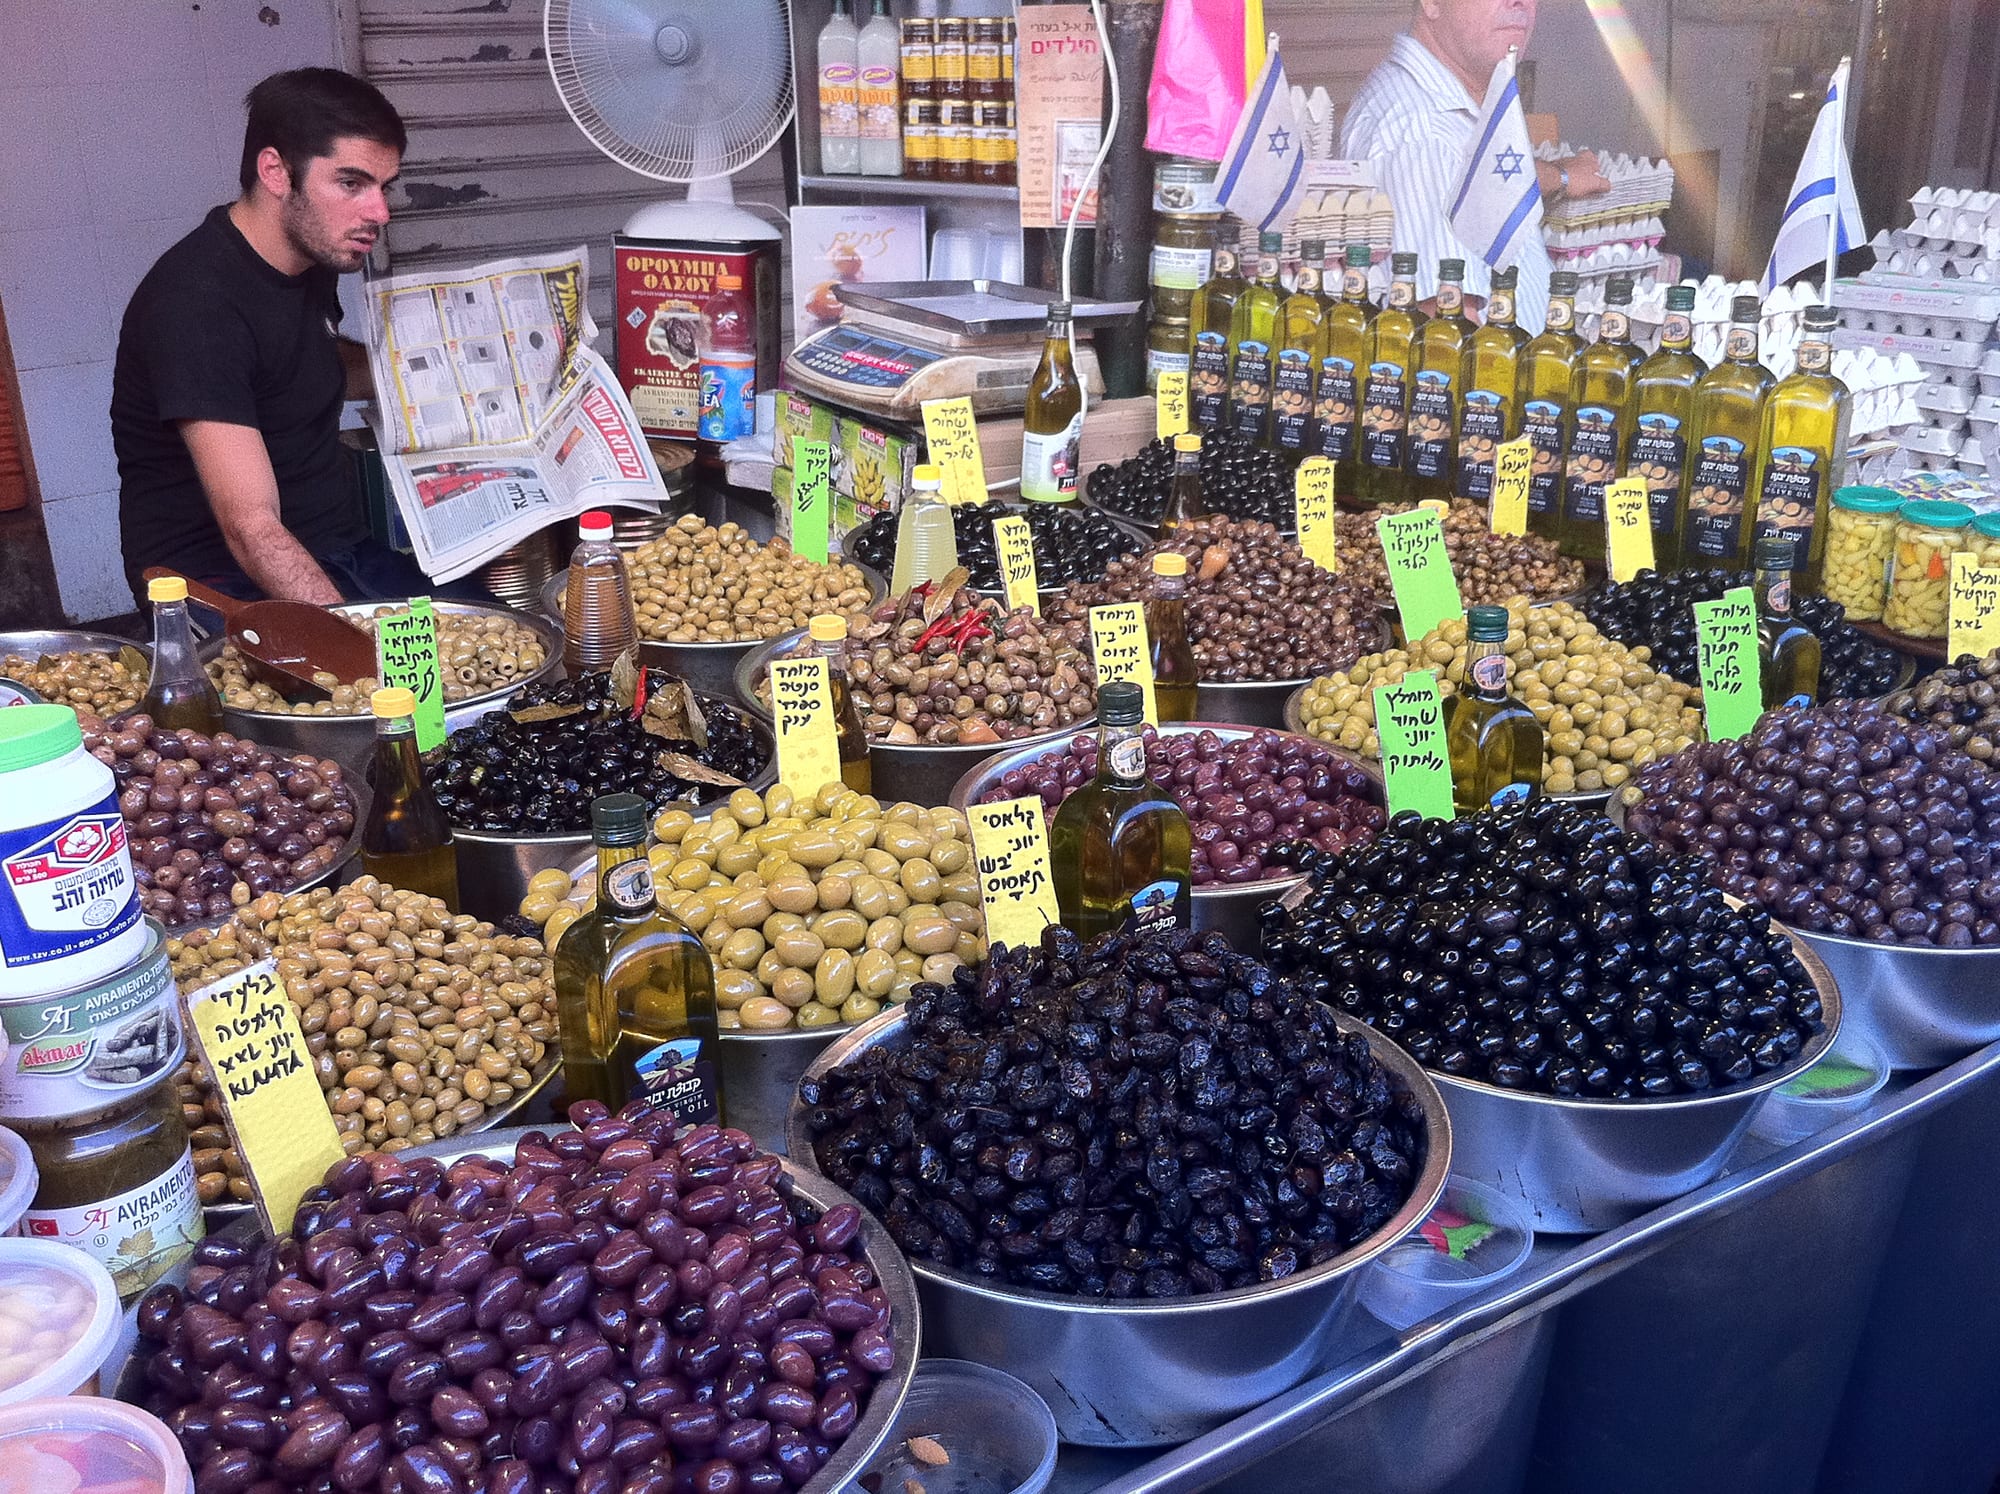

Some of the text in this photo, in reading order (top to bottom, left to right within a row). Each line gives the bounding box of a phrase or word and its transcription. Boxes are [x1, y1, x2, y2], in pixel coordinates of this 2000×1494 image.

[1030, 36, 1098, 54] הילדים
[932, 417, 967, 428] שחור
[804, 447, 826, 456] סורי
[806, 458, 827, 473] ענק
[1695, 475, 1741, 487] OLIVE OIL
[1764, 486, 1812, 499] OLIVE OIL
[1002, 525, 1028, 537] חדש
[1695, 516, 1733, 530] שמן זית
[1763, 528, 1803, 542] שמן זית
[1095, 609, 1136, 621] מיוחד
[1710, 604, 1751, 618] מיוחד
[387, 616, 431, 632] מיוחד
[1119, 623, 1139, 636] יווני
[1102, 646, 1138, 657] אדום
[775, 663, 820, 678] מיוחד
[779, 682, 819, 698] סנטה
[1385, 688, 1434, 713] מומלץ
[1391, 706, 1437, 727] שחור
[782, 714, 812, 736] ענק
[1405, 731, 1436, 747] יווני
[982, 804, 1035, 831] קלאסי
[1007, 836, 1040, 852] יווני
[979, 853, 1012, 875] יבש
[52, 866, 125, 912] טחינה זהב
[211, 974, 276, 1014] בלעדי
[215, 1003, 285, 1043] קלמטה
[23, 1039, 88, 1069] akmar
[688, 1099, 710, 1113] OIL
[117, 1160, 192, 1223] AVRAMENTO
[132, 1212, 160, 1231] מלח
